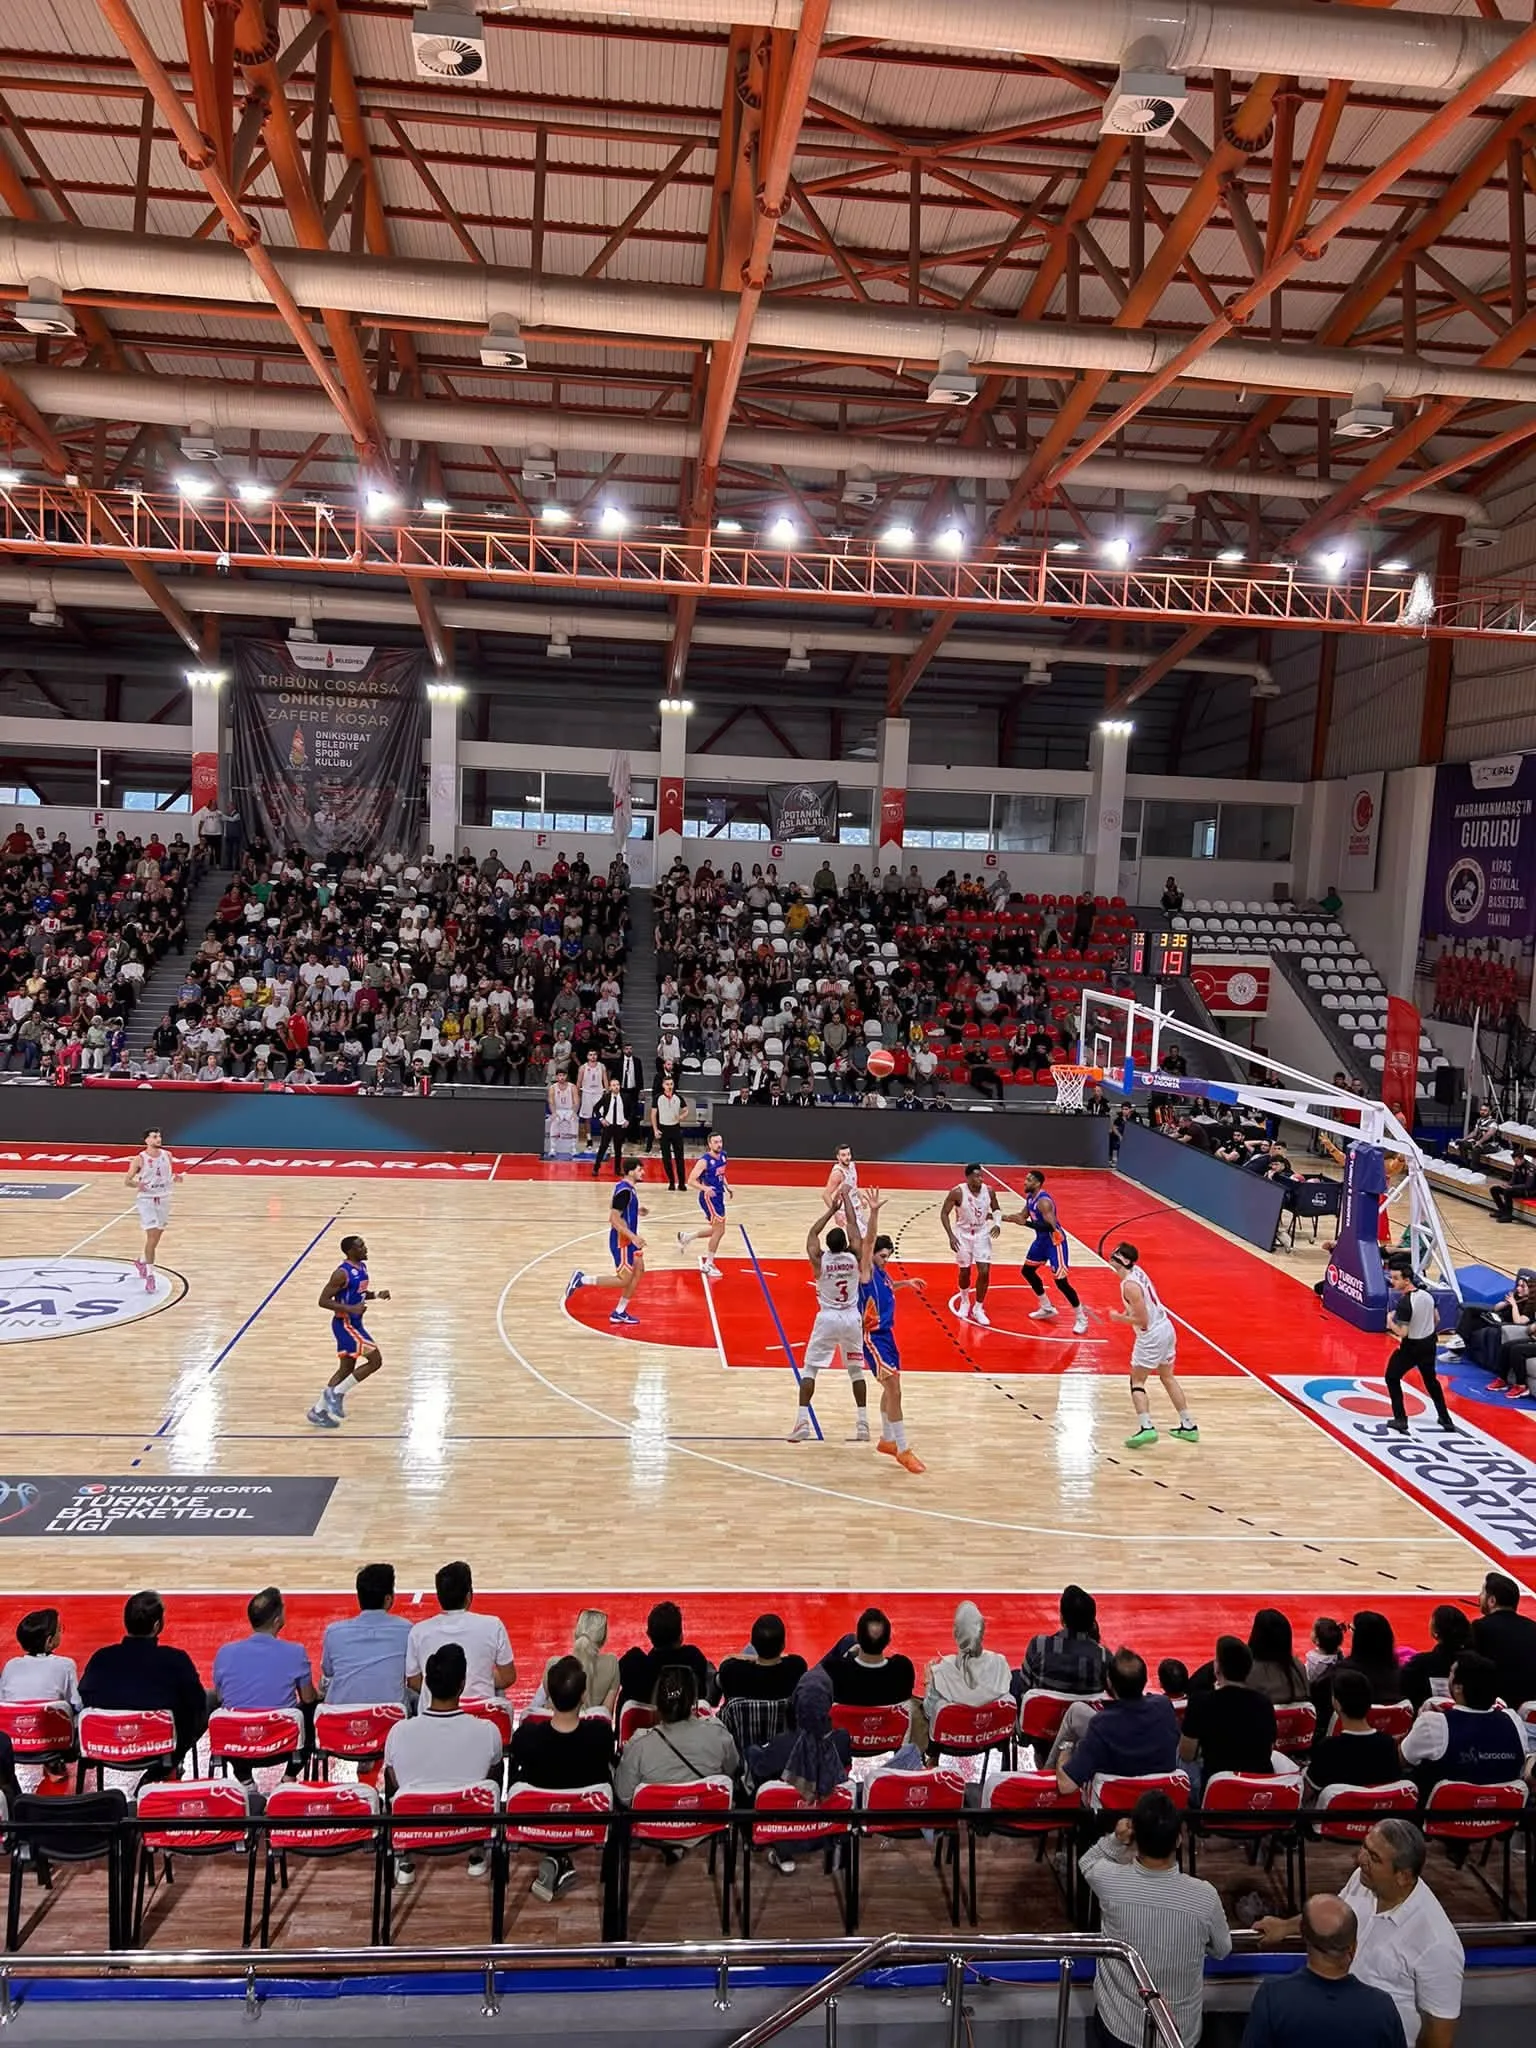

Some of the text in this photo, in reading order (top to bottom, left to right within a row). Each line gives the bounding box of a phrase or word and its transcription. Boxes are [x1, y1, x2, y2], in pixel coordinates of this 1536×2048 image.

[259, 673, 400, 696] TRİBÜN COŞARSA
[279, 690, 380, 711] ONİKİŞUBAT
[267, 707, 389, 729] ZAFERE KOŞAR
[315, 749, 340, 758] SPOR
[95, 813, 104, 825] F
[537, 834, 546, 846] F
[1461, 818, 1520, 848] GURURU
[771, 845, 783, 857] G
[986, 854, 997, 866] G
[1162, 951, 1183, 975] 19
[835, 1280, 849, 1303] 3
[71, 1494, 209, 1508] TÜRKİYE
[55, 1507, 255, 1520] BASKETBOL
